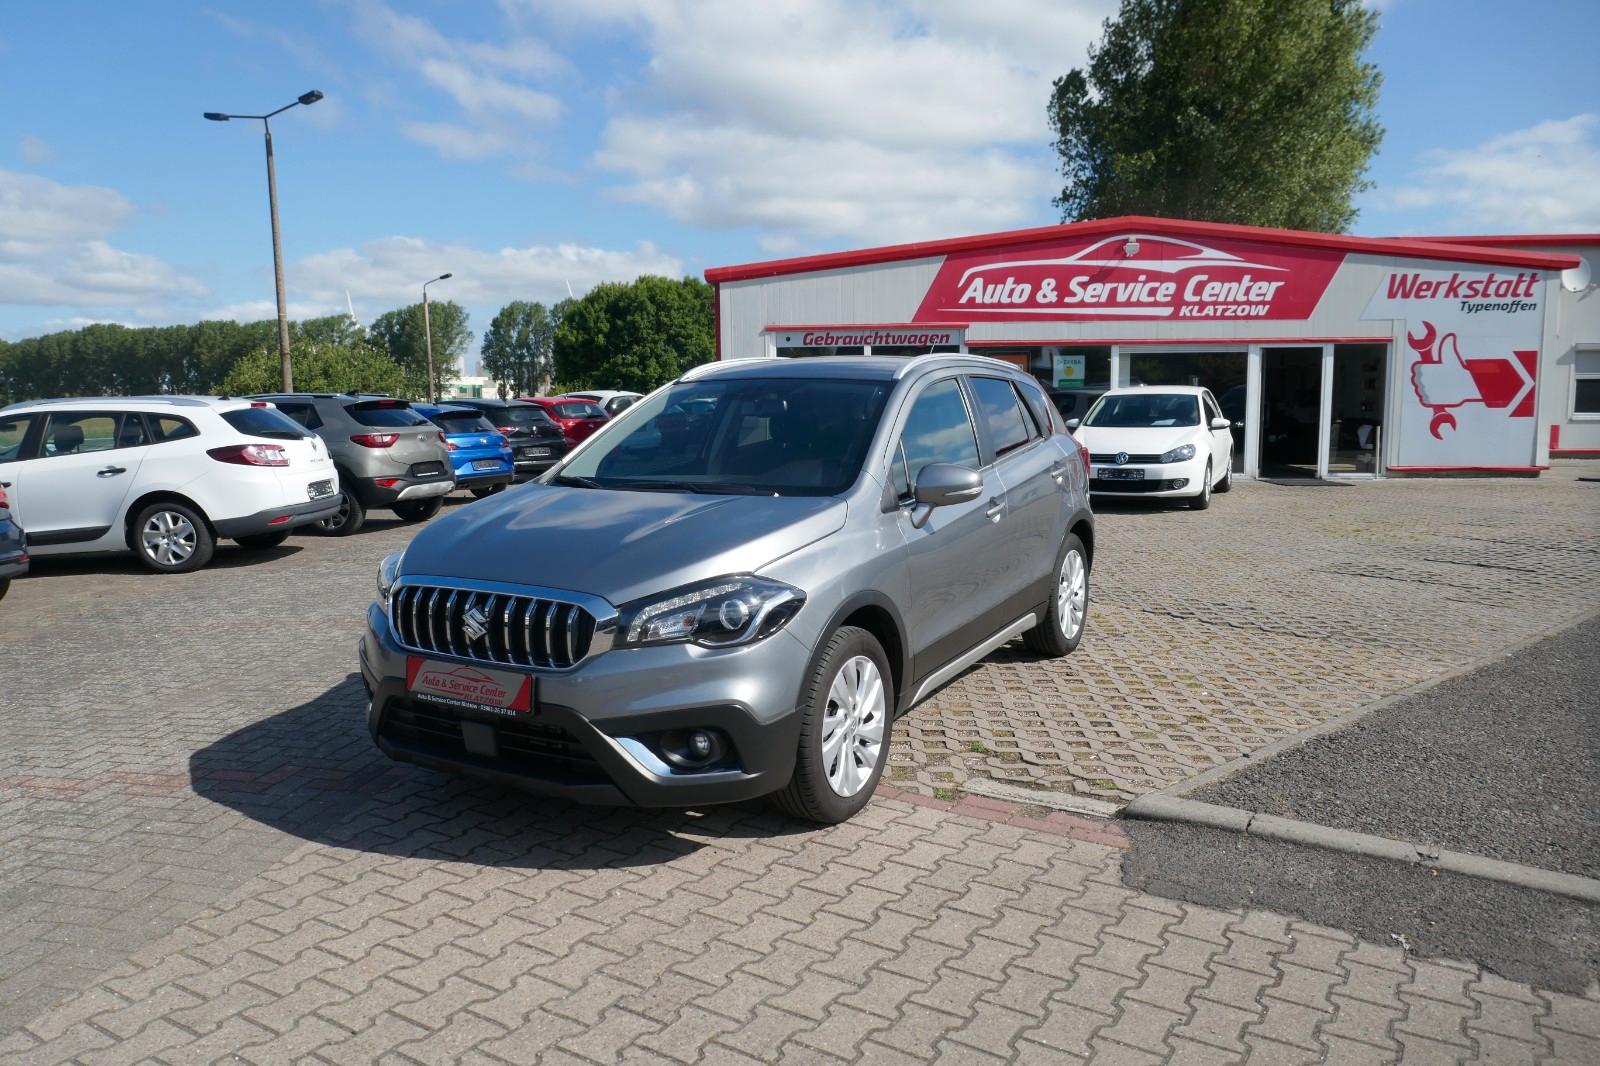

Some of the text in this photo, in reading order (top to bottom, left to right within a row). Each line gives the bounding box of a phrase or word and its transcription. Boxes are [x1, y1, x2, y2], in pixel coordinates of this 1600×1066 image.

[959, 274, 1285, 304] Auto & Service Center
[1387, 273, 1541, 300] Werkstatt
[1179, 305, 1270, 317] KLATZOW
[1460, 300, 1537, 314] Typenoffen
[803, 331, 951, 347] Gebrauchtwagen
[422, 675, 507, 698] Auto & Service Center
[431, 695, 446, 703] Service
